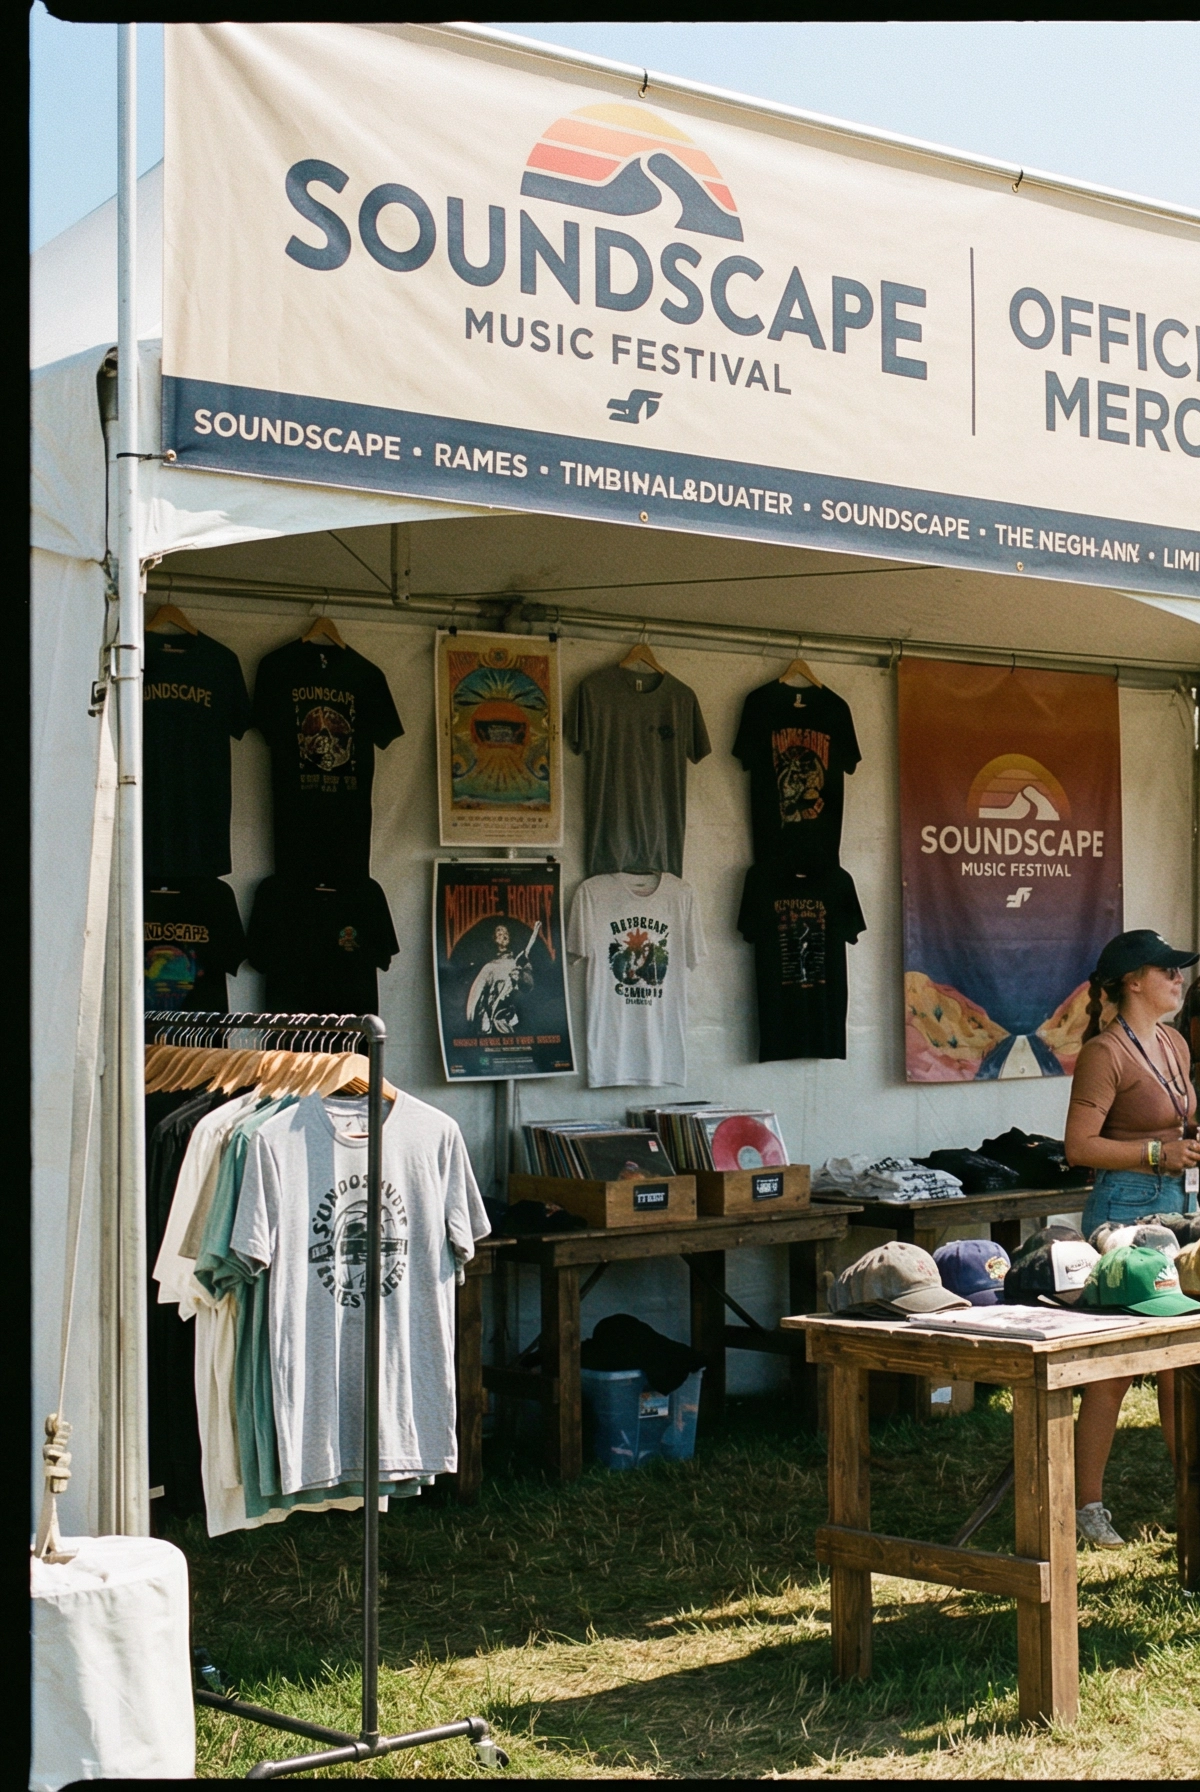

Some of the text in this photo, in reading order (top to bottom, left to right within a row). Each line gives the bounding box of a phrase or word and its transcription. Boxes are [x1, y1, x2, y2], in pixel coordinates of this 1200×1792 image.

[284, 157, 928, 381] SOUNDSCAPE
[465, 306, 793, 396] MUSIC FESTIVAL
[193, 408, 402, 461] SOUNDSCAPE
[435, 443, 528, 478] RAMES
[821, 499, 971, 541] SOUNDSCAPE
[994, 523, 1035, 549] THE
[920, 824, 1105, 858] SOUNDSCAPE
[961, 861, 1072, 878] MUSIC FESTIVAL
